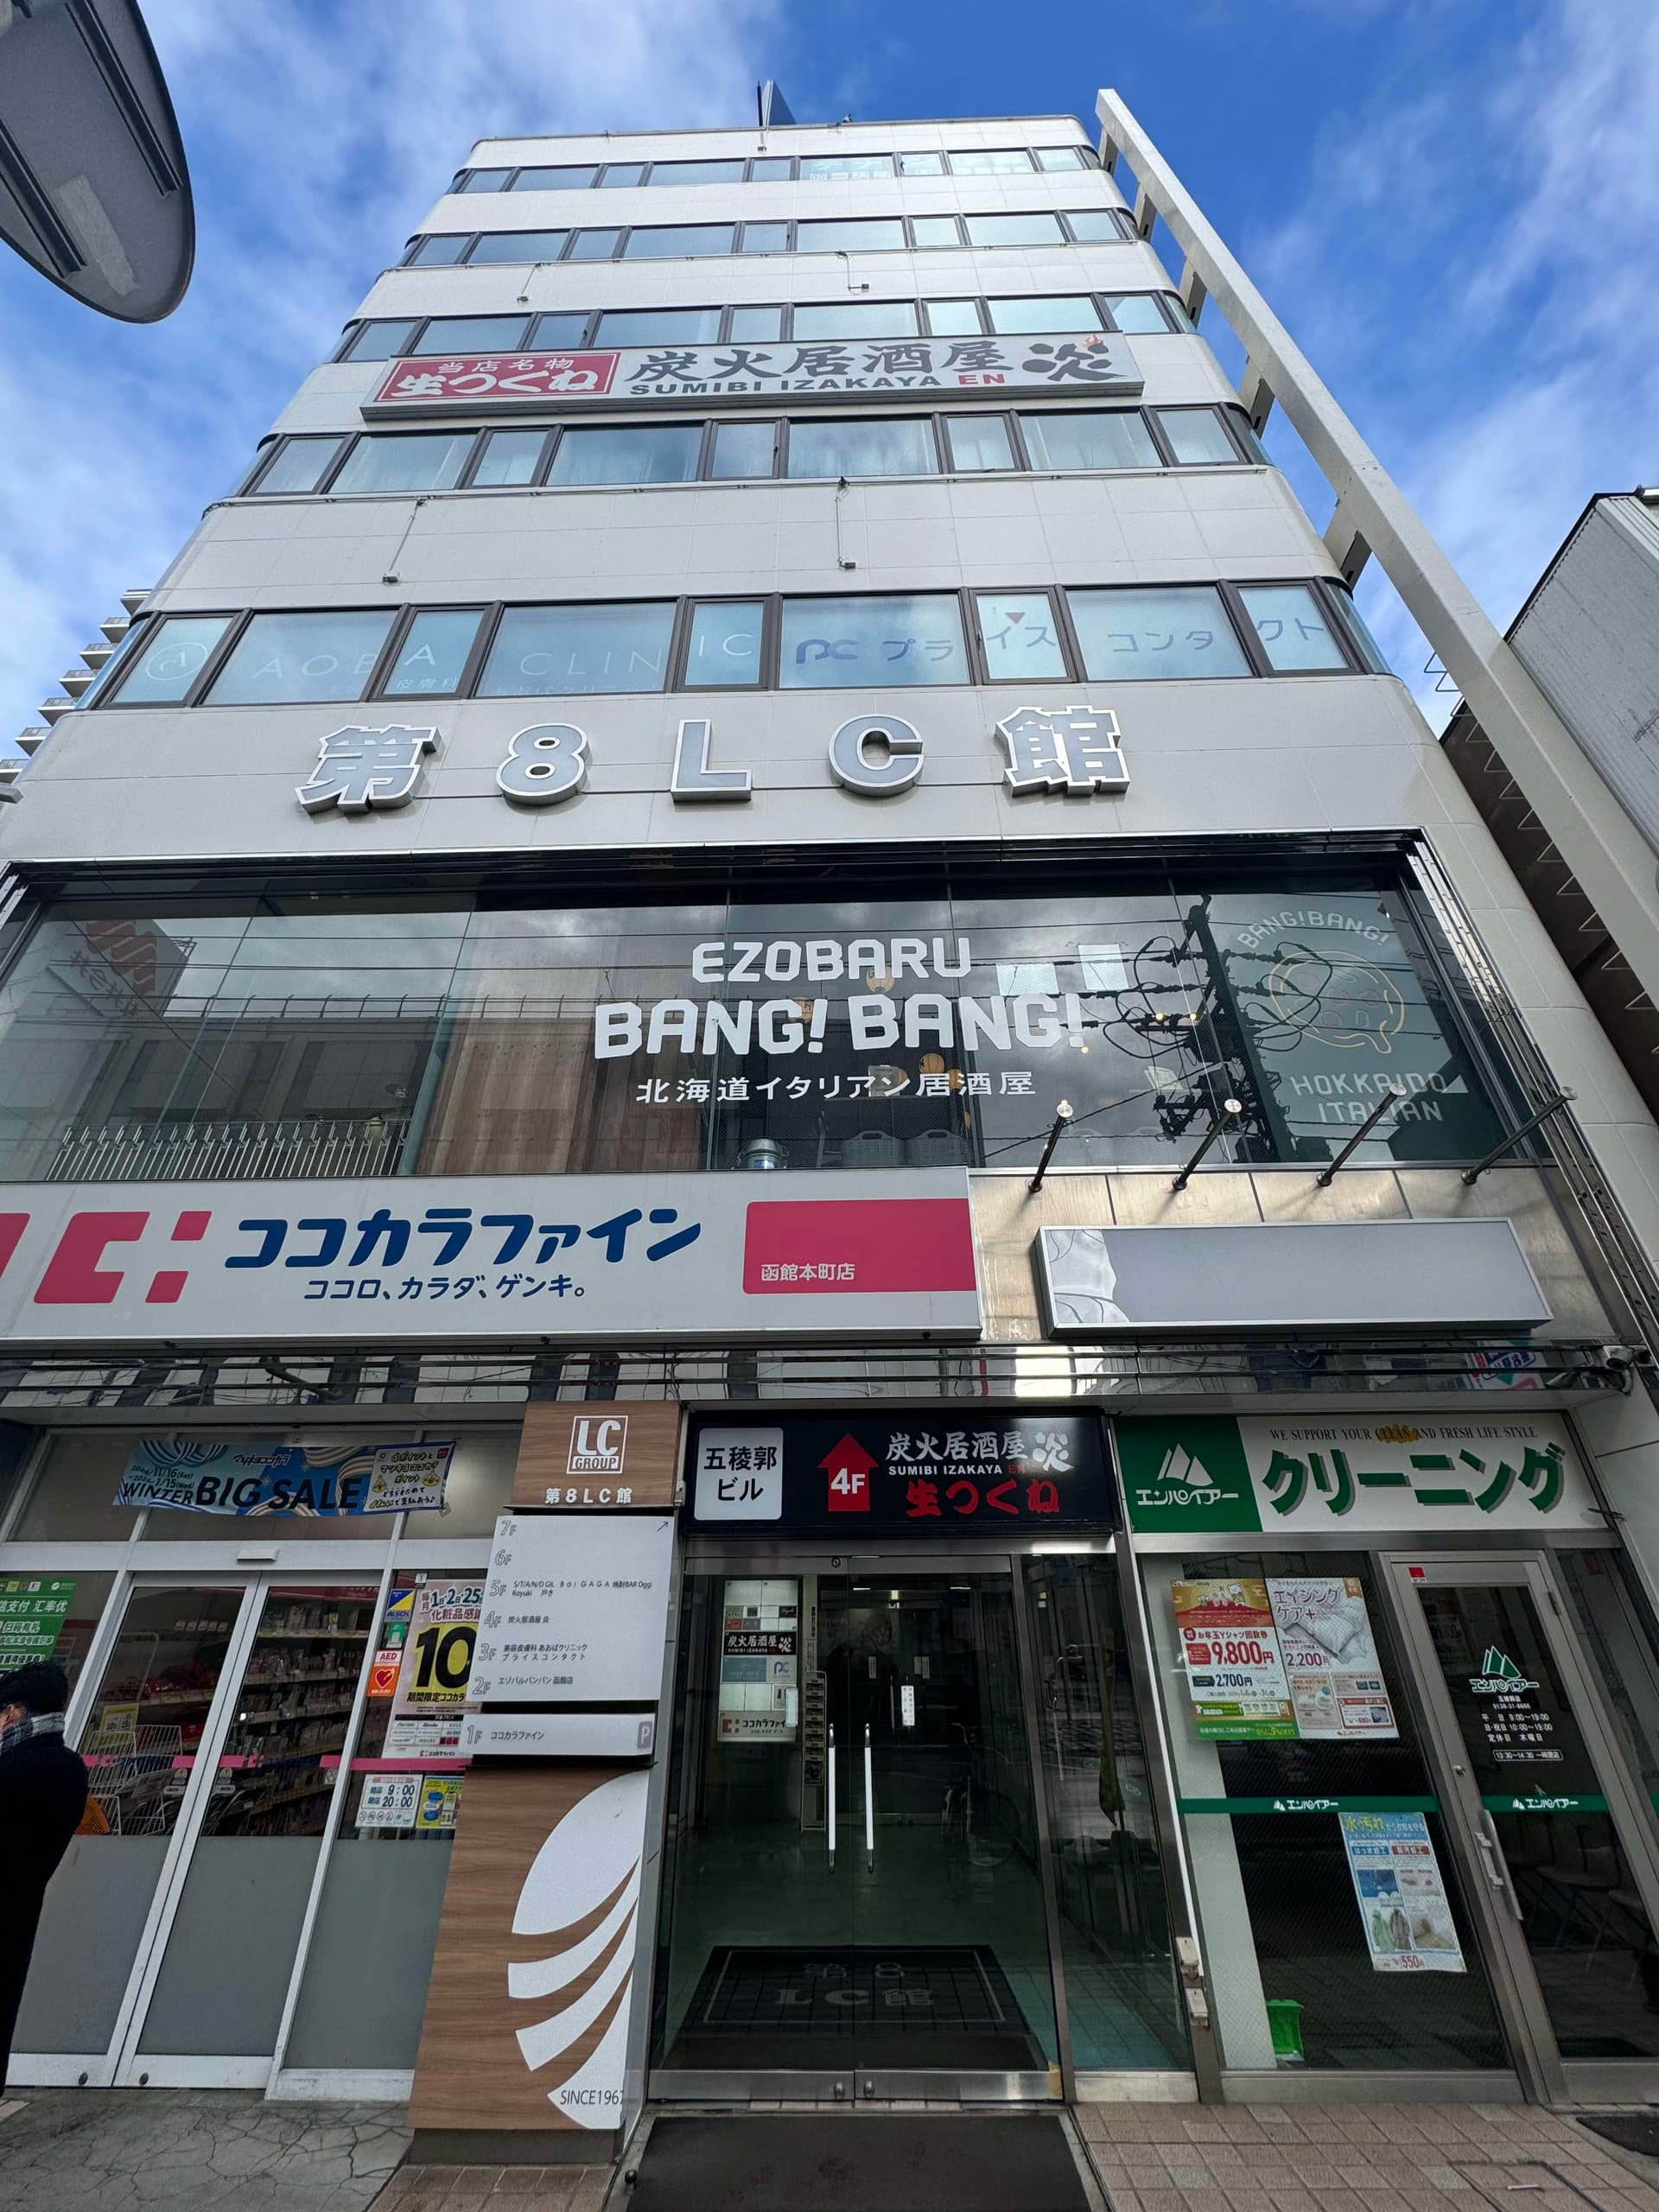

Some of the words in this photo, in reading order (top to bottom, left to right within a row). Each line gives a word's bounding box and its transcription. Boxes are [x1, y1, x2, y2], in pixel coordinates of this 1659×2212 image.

[437, 358, 574, 373] 当店名物
[624, 340, 1014, 382] 炭火居酒屋
[391, 370, 598, 397] 生つくね
[630, 381, 762, 396] SUMIBI
[780, 375, 942, 391] IZAKAYA
[958, 373, 1006, 385] EN
[520, 633, 754, 675] CLINIC
[692, 937, 972, 983] EZOBARU
[594, 998, 829, 1059] BANG!
[848, 992, 1084, 1052] BANG!
[635, 1071, 1037, 1104] 北海道イタリアン居酒屋
[1291, 1071, 1447, 1096] HOKKAIDO
[1318, 1100, 1444, 1122] ITALIAN
[225, 1207, 702, 1268] ココカラファイン
[760, 1262, 855, 1282] 函館本町店
[303, 1274, 585, 1300] ココロ、カラダ、ゲンキ。
[576, 1420, 621, 1457] LC
[1269, 1429, 1288, 1440] WE
[1291, 1429, 1337, 1440] SUPPORT
[1341, 1429, 1371, 1440] YOUR
[1415, 1428, 1437, 1439] AND
[1440, 1427, 1473, 1439] FRESH
[1477, 1427, 1500, 1438] LIFE
[1504, 1427, 1538, 1438] STYLE
[885, 1431, 1028, 1462] 炭火居酒屋
[575, 1457, 617, 1469] GROUP
[703, 1446, 778, 1471] 五稜郭
[831, 1467, 866, 1495] 4F
[888, 1465, 938, 1476] SUMIBI
[943, 1465, 1003, 1475] IZAKAYA
[1007, 1464, 1027, 1474] EN
[1262, 1441, 1567, 1516] クリーニング
[124, 1482, 194, 1506] WINTER
[195, 1476, 264, 1508] BIG
[267, 1477, 363, 1510] SALE
[544, 1486, 633, 1504] 第8LC館
[717, 1478, 764, 1502] ビル
[906, 1478, 1060, 1517] 生つくね
[500, 1521, 518, 1536] 7F
[495, 1549, 512, 1566] 6F
[490, 1580, 506, 1596] 5F
[484, 1611, 502, 1628] 4F
[478, 1643, 497, 1661] 3F
[727, 1635, 778, 1648] 炭火居酒屋
[380, 1652, 397, 1661] AED
[416, 1626, 477, 1689] 10
[1211, 1640, 1274, 1666] 9,800円
[473, 1676, 492, 1694] 2F
[1215, 1673, 1253, 1688] 2,700円
[467, 1725, 483, 1744] 1F
[742, 1719, 786, 1728] ココカラファイ
[490, 1731, 545, 1740] ココカラファイン
[1487, 1733, 1512, 1742] 定休日
